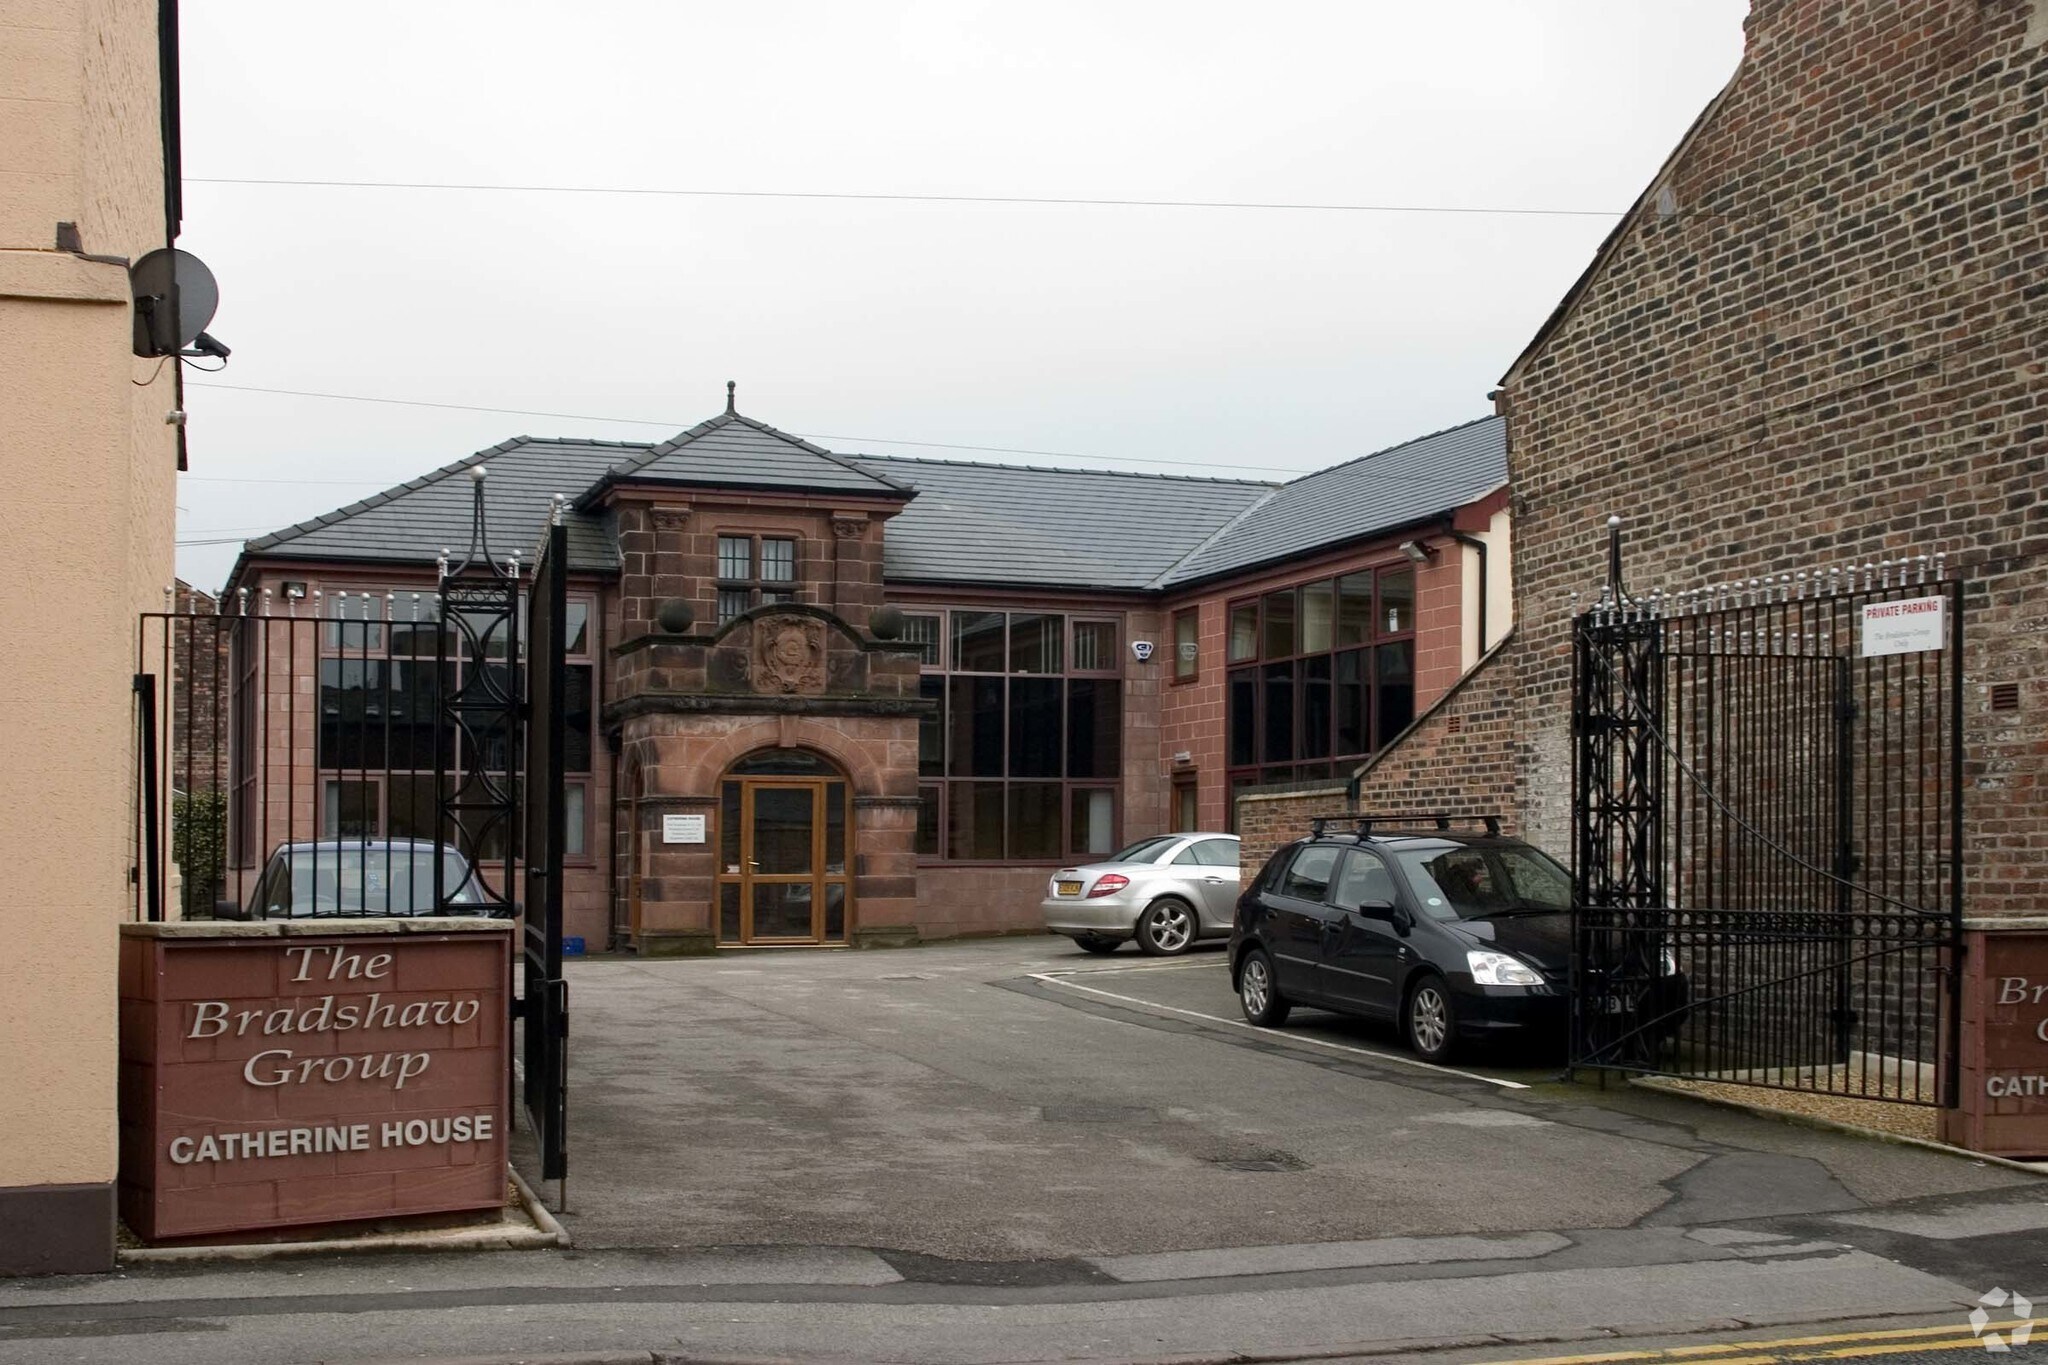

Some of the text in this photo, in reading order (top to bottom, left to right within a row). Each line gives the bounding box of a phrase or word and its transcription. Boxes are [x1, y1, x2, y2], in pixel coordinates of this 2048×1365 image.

[1866, 600, 1938, 619] PRIVATE PARKING
[286, 945, 392, 982] The
[187, 993, 480, 1039] Bradshaw
[244, 1049, 430, 1089] Group
[169, 1114, 493, 1164] CATHERINE HOUSE
